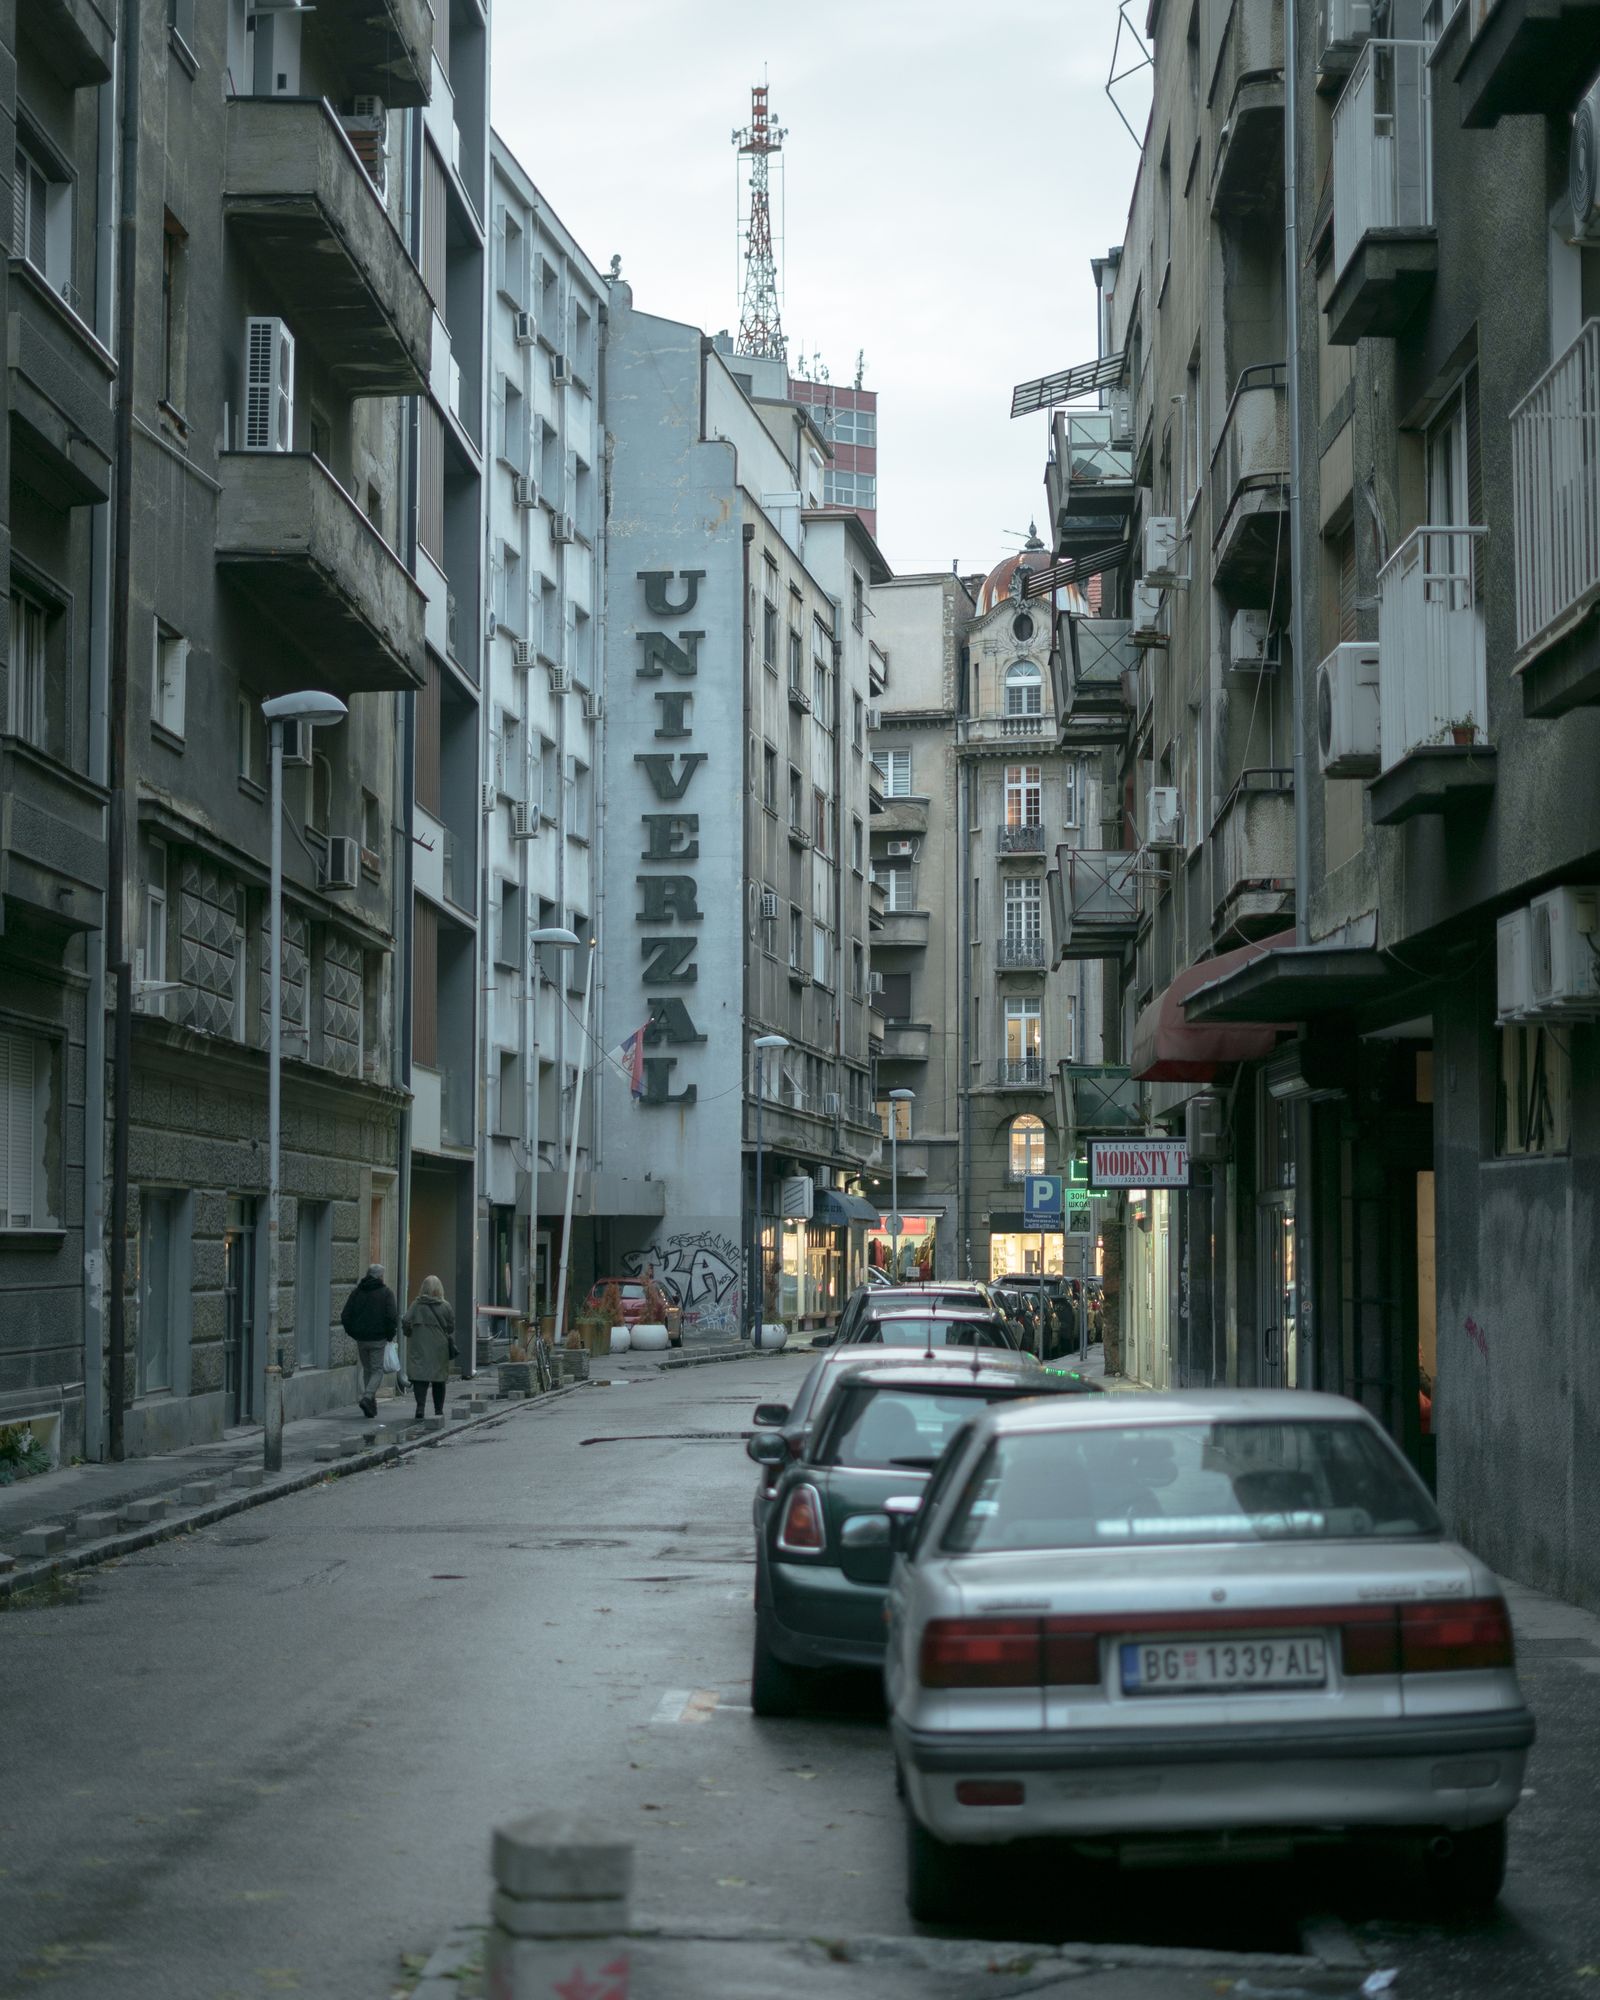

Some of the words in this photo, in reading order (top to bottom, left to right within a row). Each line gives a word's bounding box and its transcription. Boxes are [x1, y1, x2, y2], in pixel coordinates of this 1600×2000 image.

[634, 570, 708, 1105] UNIVERZAL
[1096, 1151, 1170, 1176] MODESTY
[1033, 1180, 1053, 1208] P
[1144, 1649, 1179, 1682] BG
